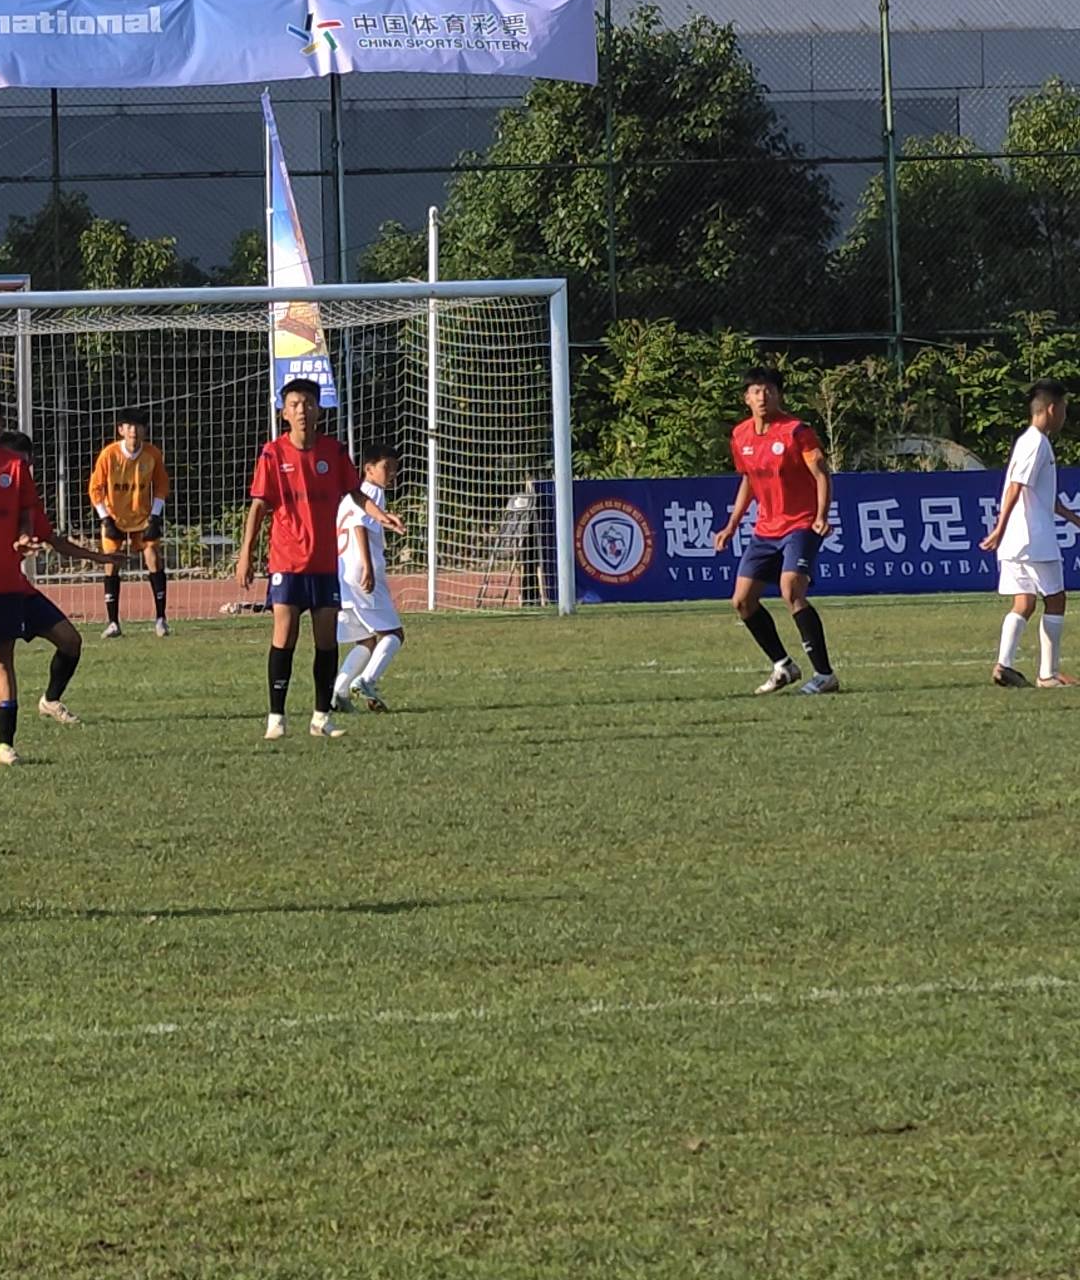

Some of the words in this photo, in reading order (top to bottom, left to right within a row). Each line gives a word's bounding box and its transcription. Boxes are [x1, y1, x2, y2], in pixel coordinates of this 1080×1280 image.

[353, 13, 528, 37] 中国体育彩票
[358, 38, 403, 49] CHINA
[406, 38, 463, 49] SPORTS
[465, 39, 530, 52] LOTTERY
